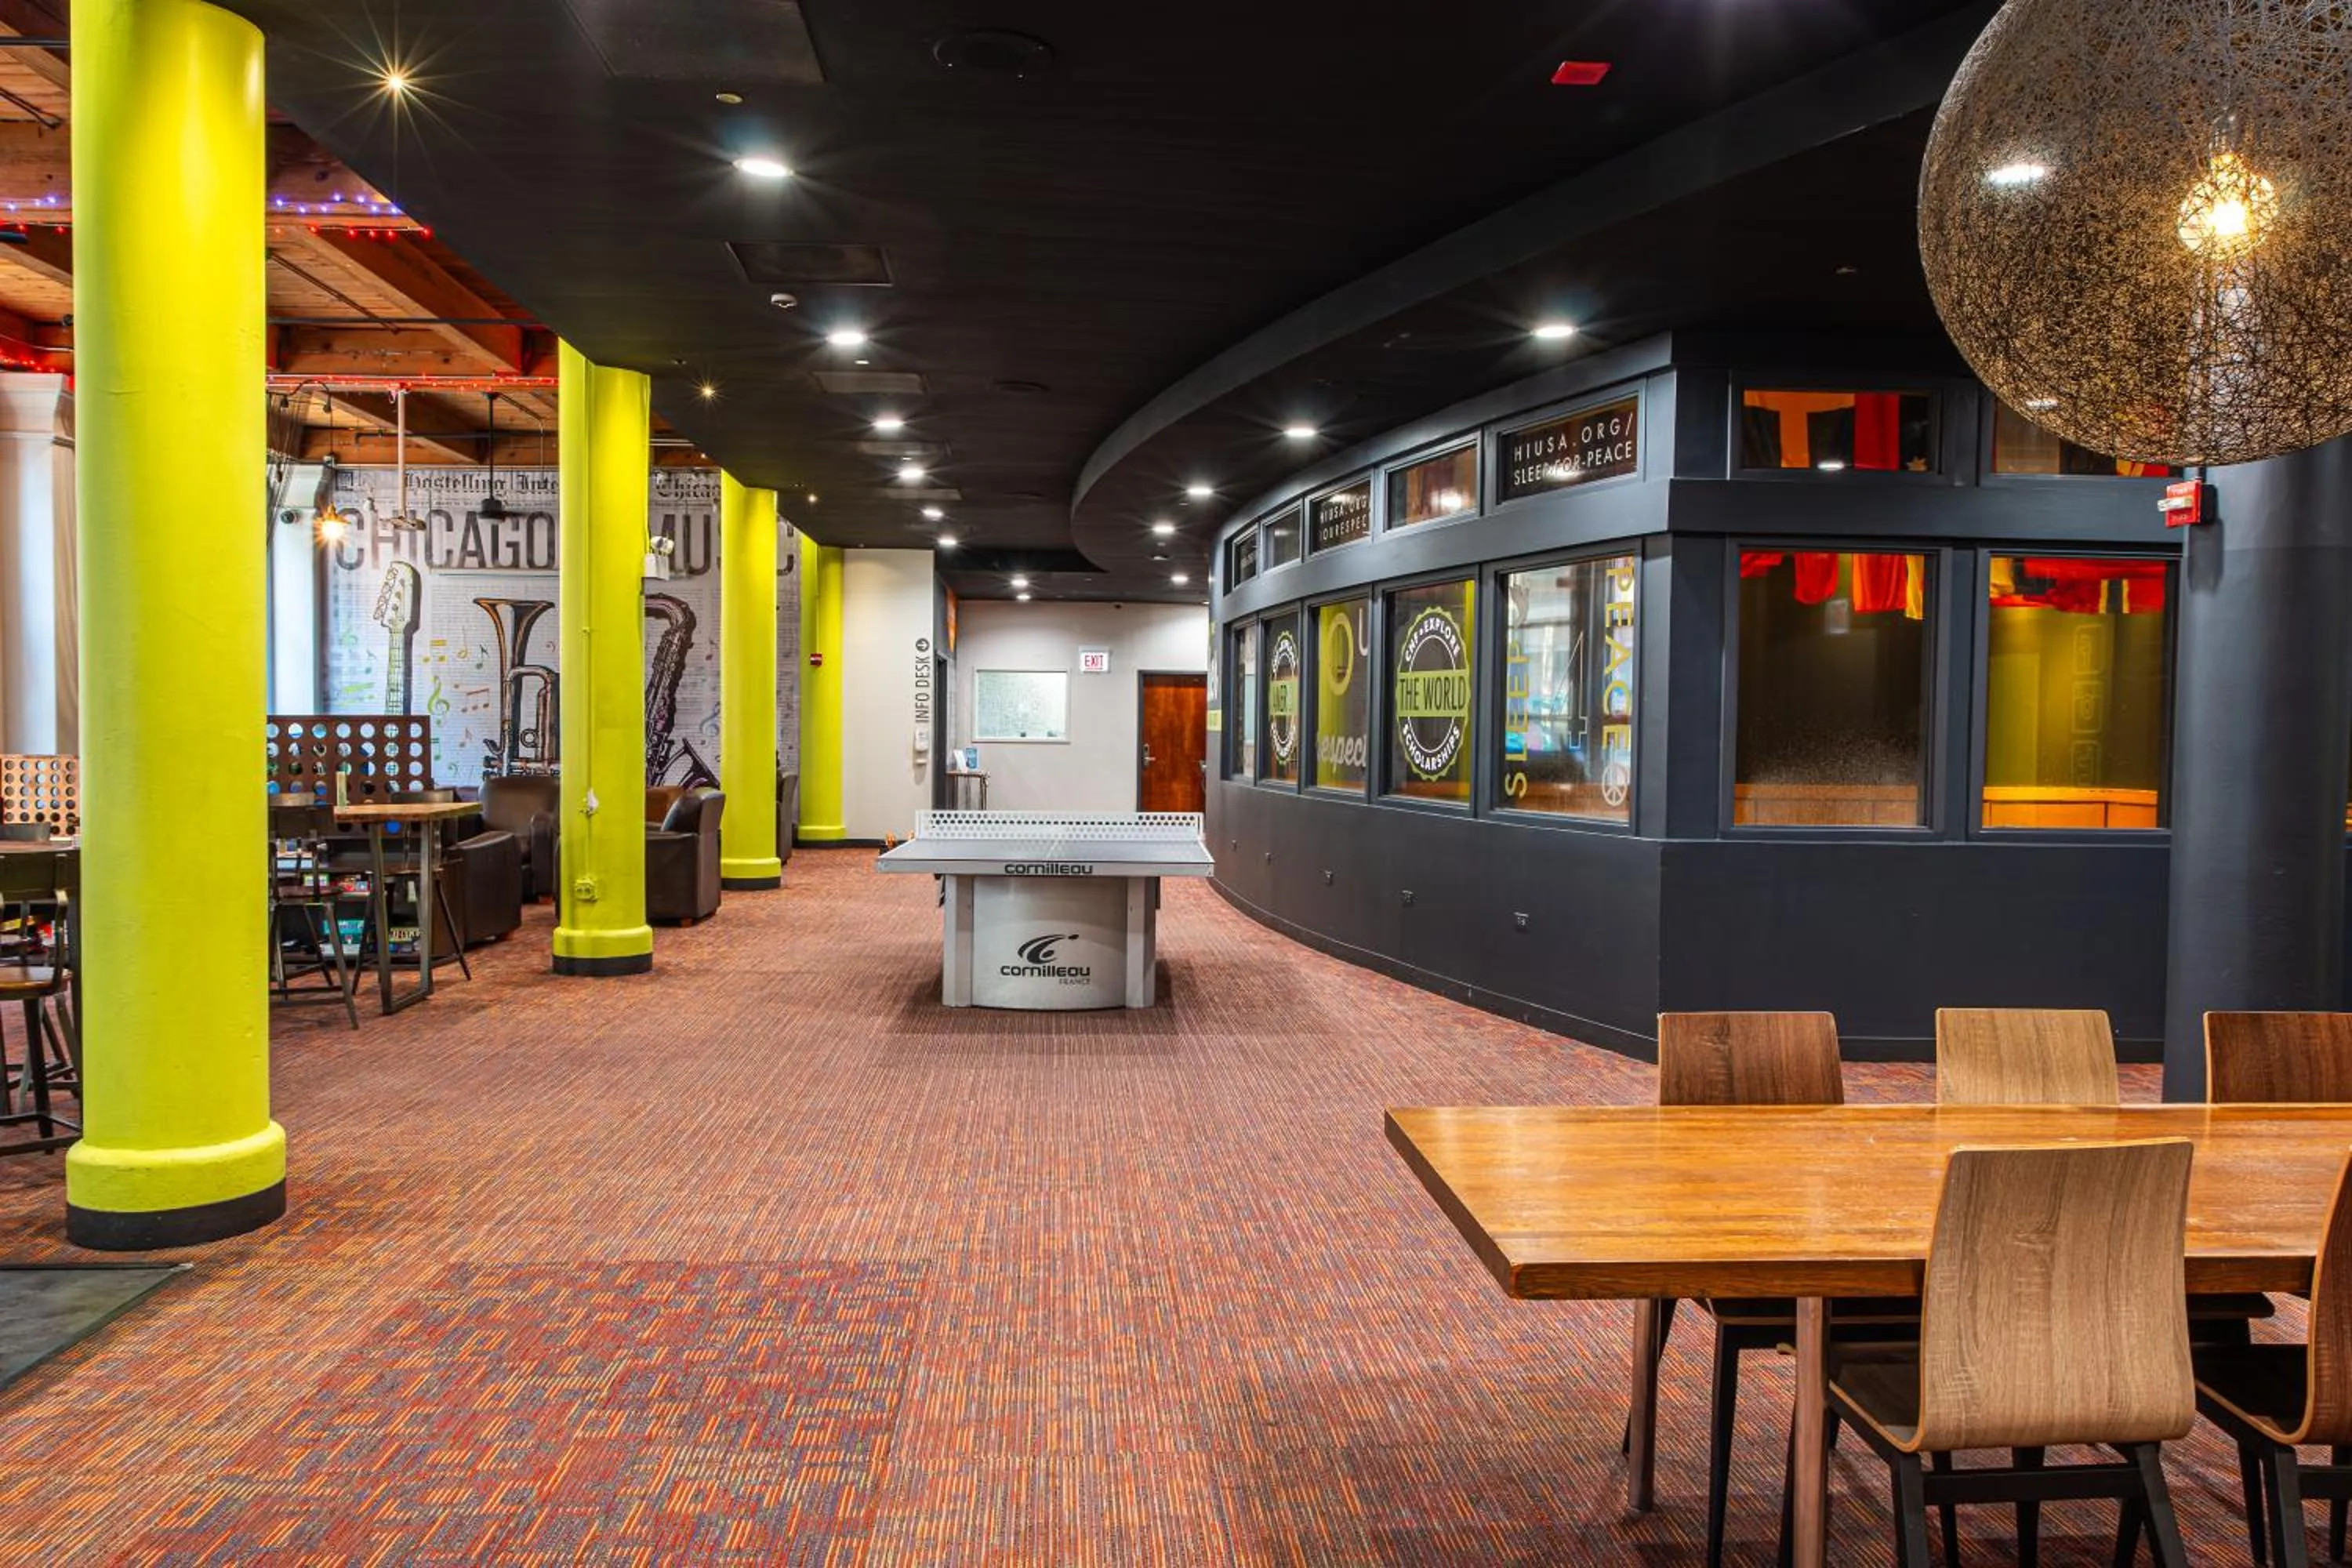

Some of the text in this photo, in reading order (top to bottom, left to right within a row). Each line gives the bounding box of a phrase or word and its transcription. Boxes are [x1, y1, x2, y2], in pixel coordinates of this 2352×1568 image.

[1514, 412, 1633, 462] HIUSA.ORG/
[336, 507, 556, 570] CHICAGO
[1084, 655, 1104, 666] EXIT
[1505, 639, 1530, 799] SLEEP
[1602, 567, 1633, 750] PEACE
[915, 656, 931, 724] INFO DESK
[1399, 676, 1467, 711] THE WORLD
[1403, 724, 1461, 771] SCHOLARSHIPS
